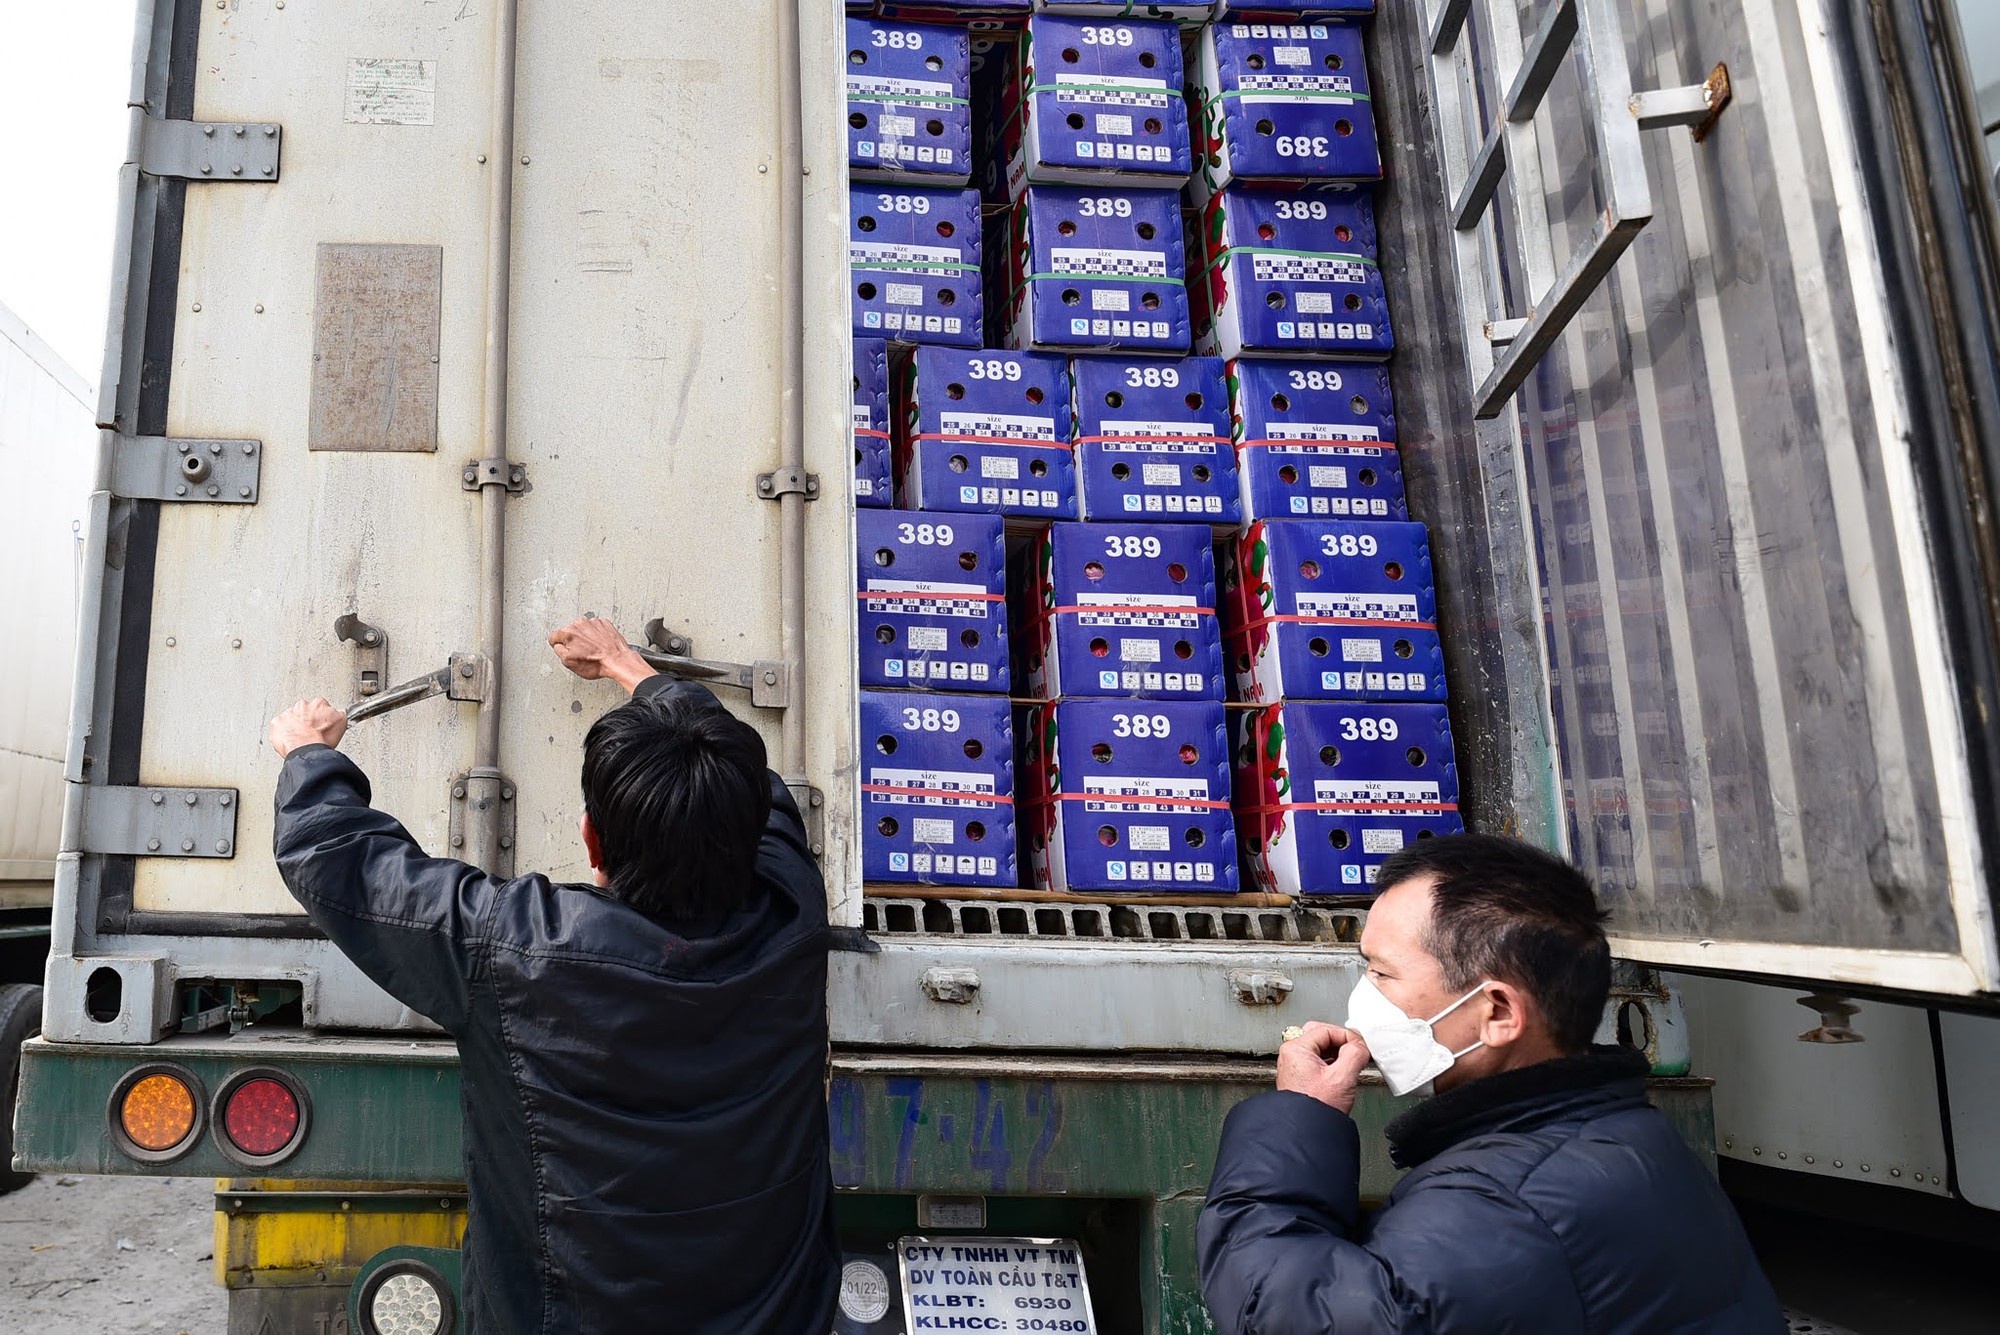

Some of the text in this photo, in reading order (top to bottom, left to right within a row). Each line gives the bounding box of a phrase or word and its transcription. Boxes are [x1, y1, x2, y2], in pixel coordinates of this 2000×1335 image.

[872, 30, 922, 50] 389
[1081, 27, 1133, 48] 389
[1277, 137, 1328, 157] 389
[878, 195, 929, 214] 389
[1079, 198, 1131, 217] 389
[1275, 201, 1326, 219] 389
[969, 360, 1021, 381] 389
[1125, 368, 1178, 387] 389
[1289, 371, 1342, 390] 389
[898, 523, 953, 546] 389
[1105, 536, 1160, 557] 389
[1321, 535, 1377, 556] 389
[903, 708, 960, 732] 389
[1113, 714, 1170, 738] 389
[1340, 718, 1398, 740] 389
[921, 772, 937, 780] size
[905, 1246, 1076, 1264] CTY TNHH VT TM
[911, 1265, 1078, 1288] DV TOÀN CẦU T&T
[847, 1281, 877, 1295] 01/22
[914, 1294, 1071, 1310] KLBT: 6930
[916, 1316, 1087, 1332] KLHCC: 30480
